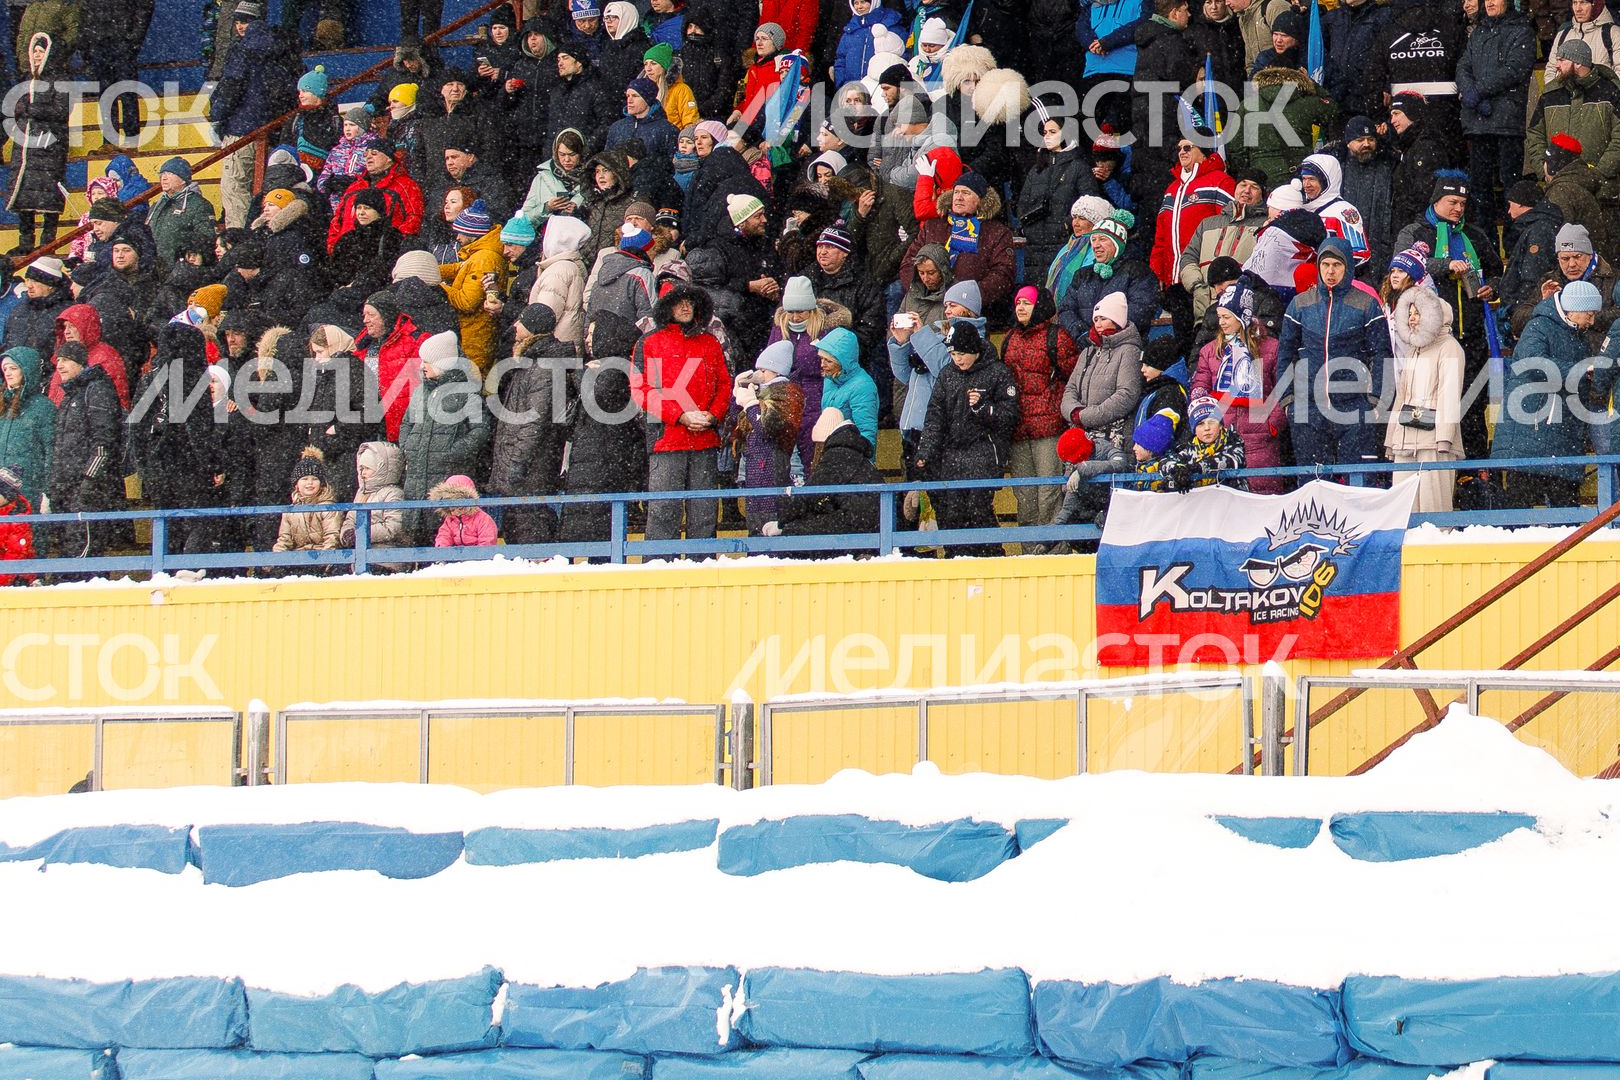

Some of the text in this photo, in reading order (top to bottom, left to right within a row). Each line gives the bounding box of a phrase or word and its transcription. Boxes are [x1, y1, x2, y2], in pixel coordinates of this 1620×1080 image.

[1390, 49, 1444, 61] COUYOR
[1253, 606, 1299, 621] ICE RACING
